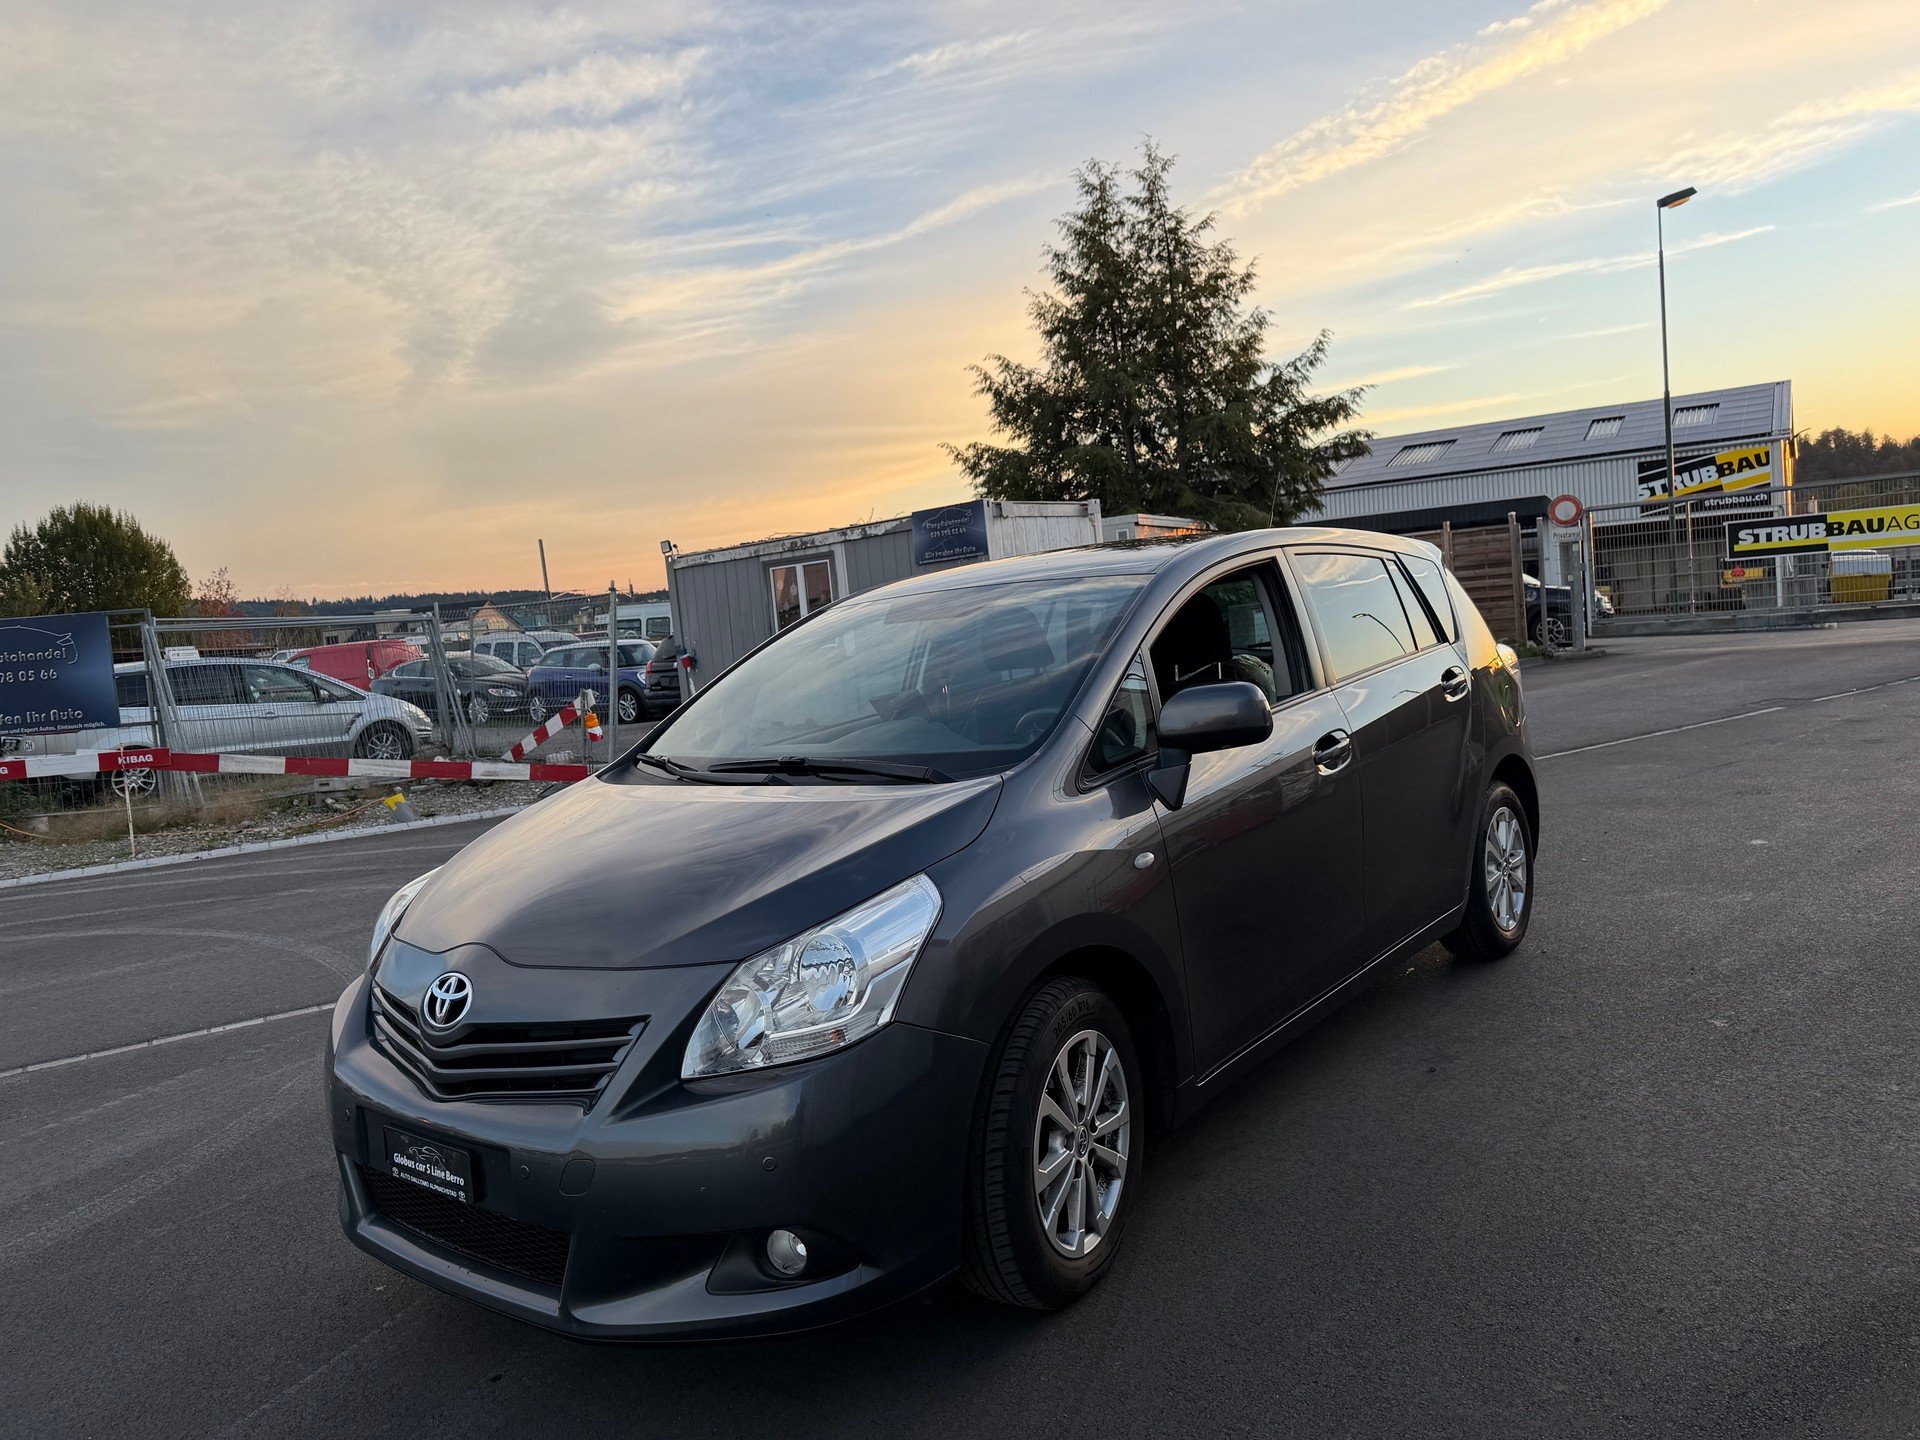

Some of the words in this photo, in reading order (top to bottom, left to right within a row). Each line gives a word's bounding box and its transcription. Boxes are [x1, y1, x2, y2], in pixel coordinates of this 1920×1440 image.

[1638, 450, 1770, 499] STRUBBAU
[1704, 493, 1768, 507] strubbau.ch
[18, 670, 35, 681] 05
[40, 669, 57, 680] 66
[26, 711, 46, 723] Ihr
[50, 708, 83, 721] Auto
[57, 723, 83, 731] Eintausch
[84, 721, 107, 729] möglich.
[118, 754, 154, 765] KIBAG
[393, 1152, 415, 1169] Globus
[415, 1162, 426, 1173] car
[426, 1163, 431, 1174] S
[431, 1165, 445, 1179] Line
[445, 1170, 465, 1186] Berro
[400, 1172, 411, 1181] AUTO
